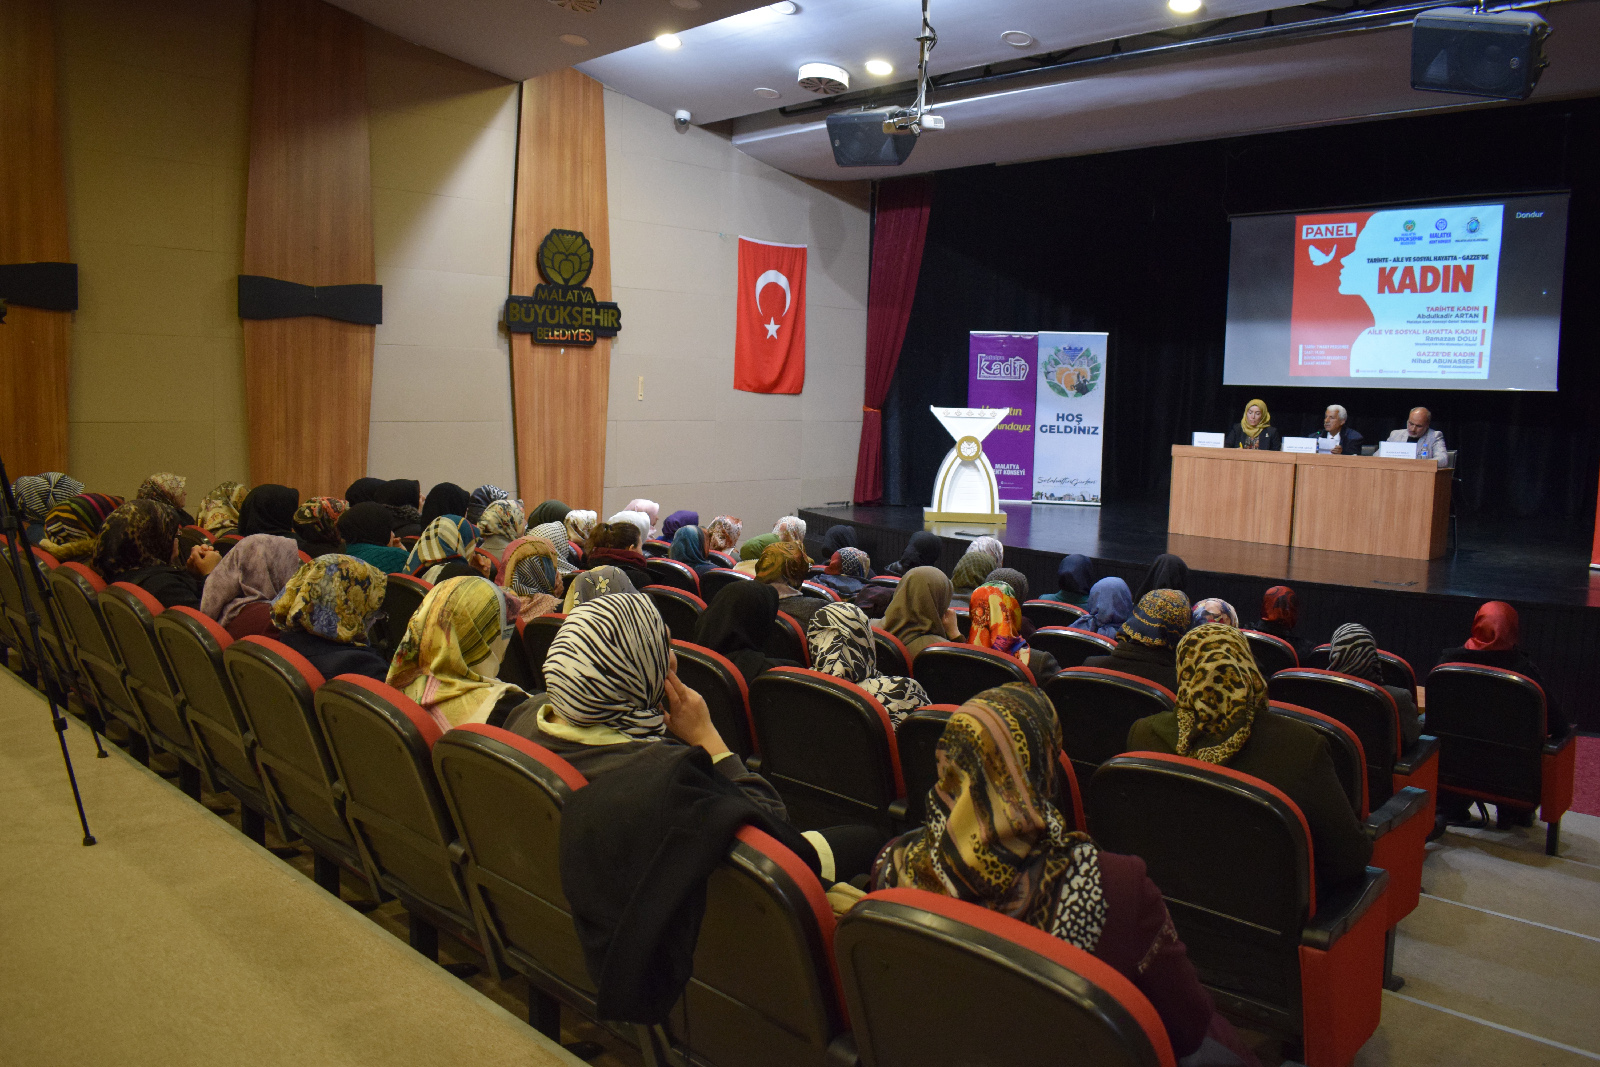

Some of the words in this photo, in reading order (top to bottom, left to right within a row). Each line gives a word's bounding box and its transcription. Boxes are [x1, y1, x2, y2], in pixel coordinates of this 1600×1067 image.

[1306, 225, 1353, 237] PANEL
[1377, 264, 1474, 294] KADIN
[538, 289, 594, 304] MALATYA
[1056, 413, 1083, 425] HOŞ
